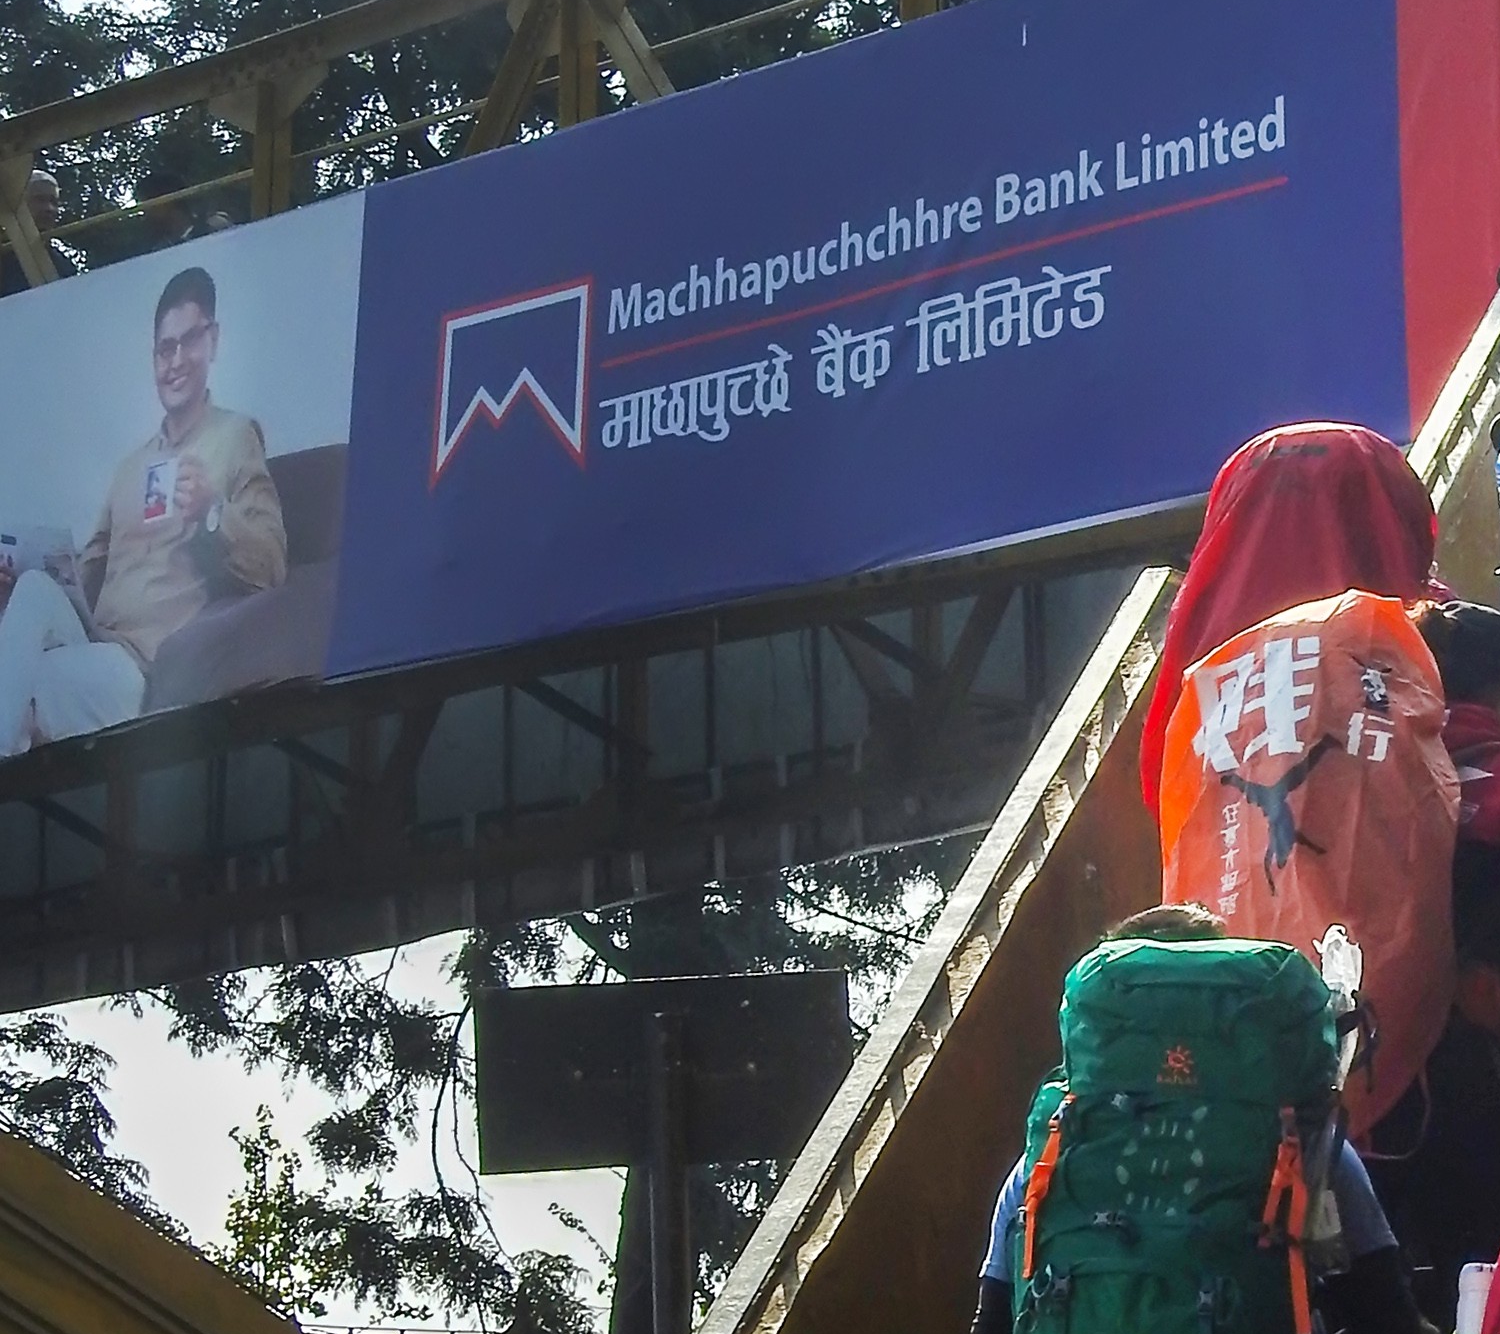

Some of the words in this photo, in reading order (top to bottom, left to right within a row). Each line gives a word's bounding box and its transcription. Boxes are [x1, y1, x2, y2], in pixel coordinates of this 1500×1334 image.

[606, 195, 983, 334] Machhapuchchhre
[995, 149, 1104, 224] Bank
[1116, 95, 1286, 191] Limited
[810, 323, 894, 398] बैंक
[905, 266, 1112, 373] लिमिटेड
